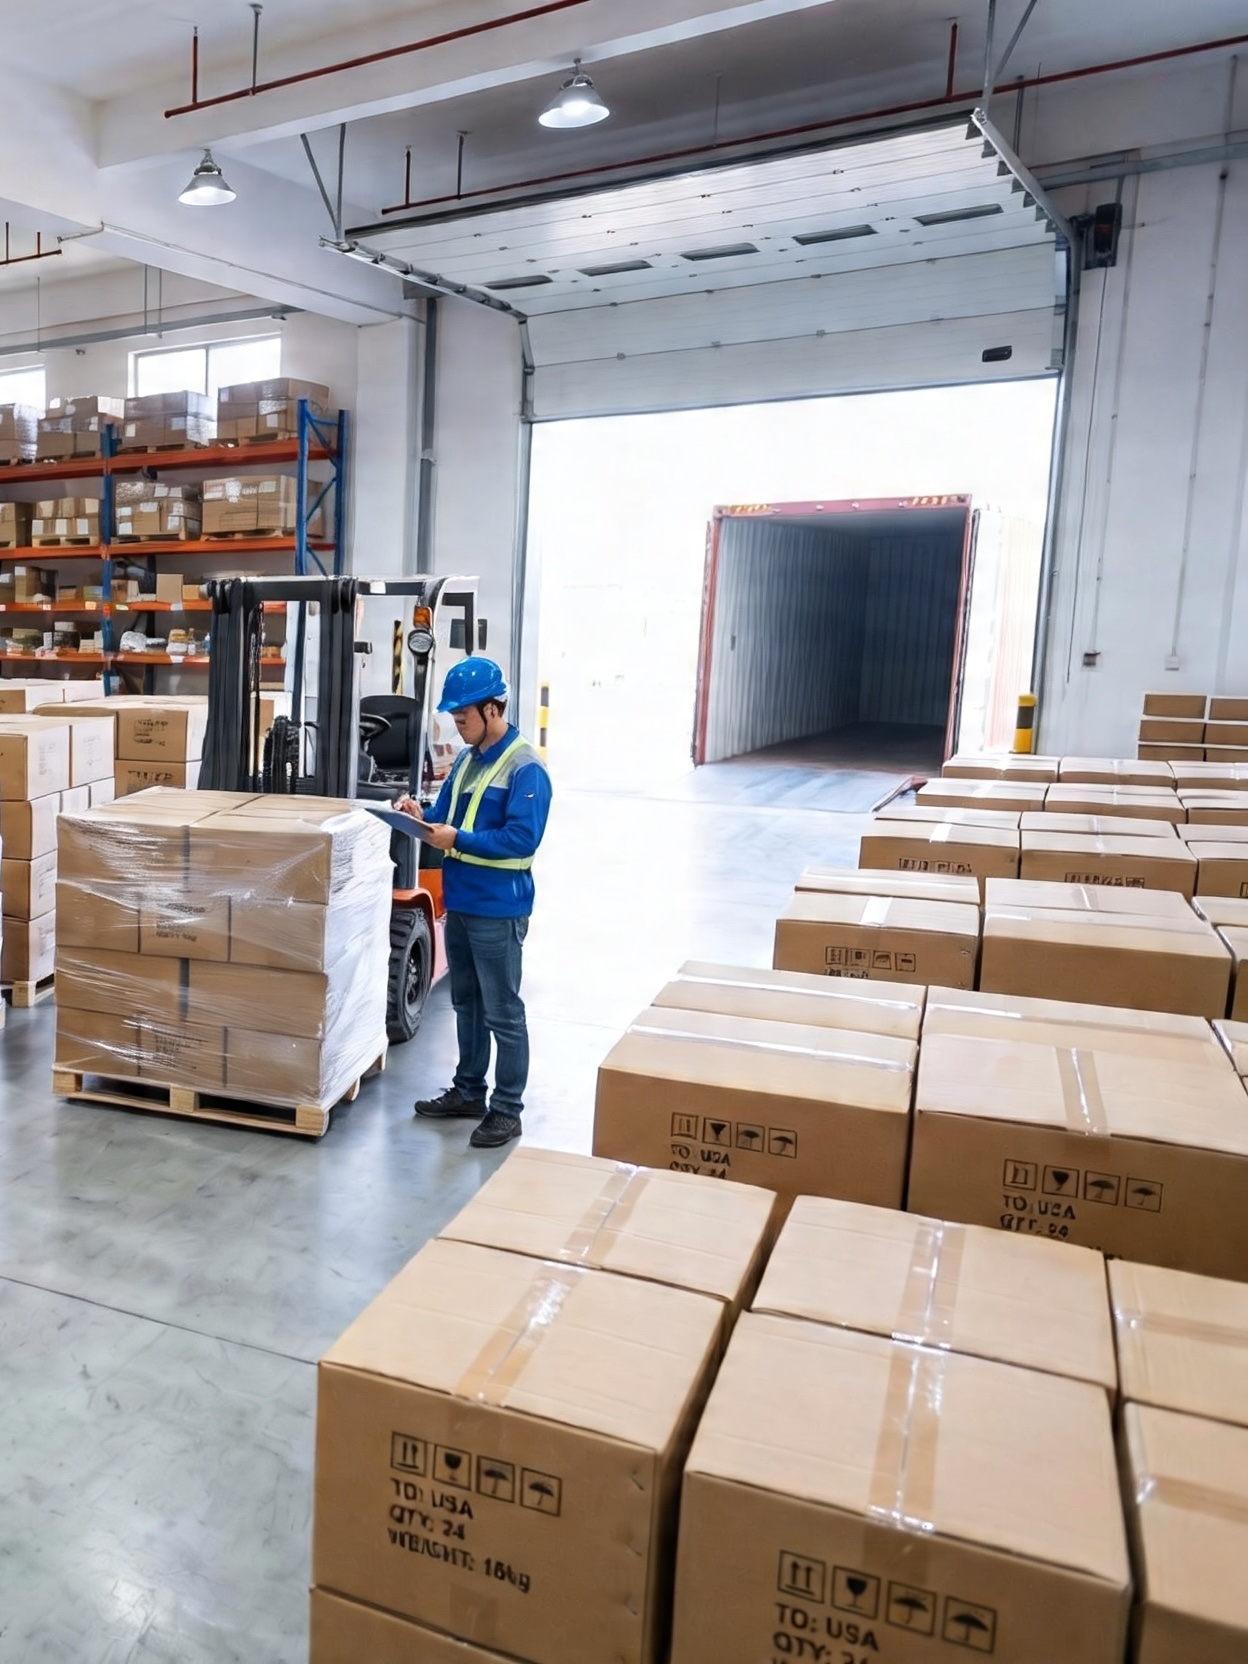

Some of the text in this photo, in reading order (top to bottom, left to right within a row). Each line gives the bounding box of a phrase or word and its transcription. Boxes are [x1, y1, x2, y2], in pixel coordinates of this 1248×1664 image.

[431, 1489, 474, 1520] USA
[441, 1518, 466, 1540] 24
[774, 1601, 880, 1652] TO: USA
